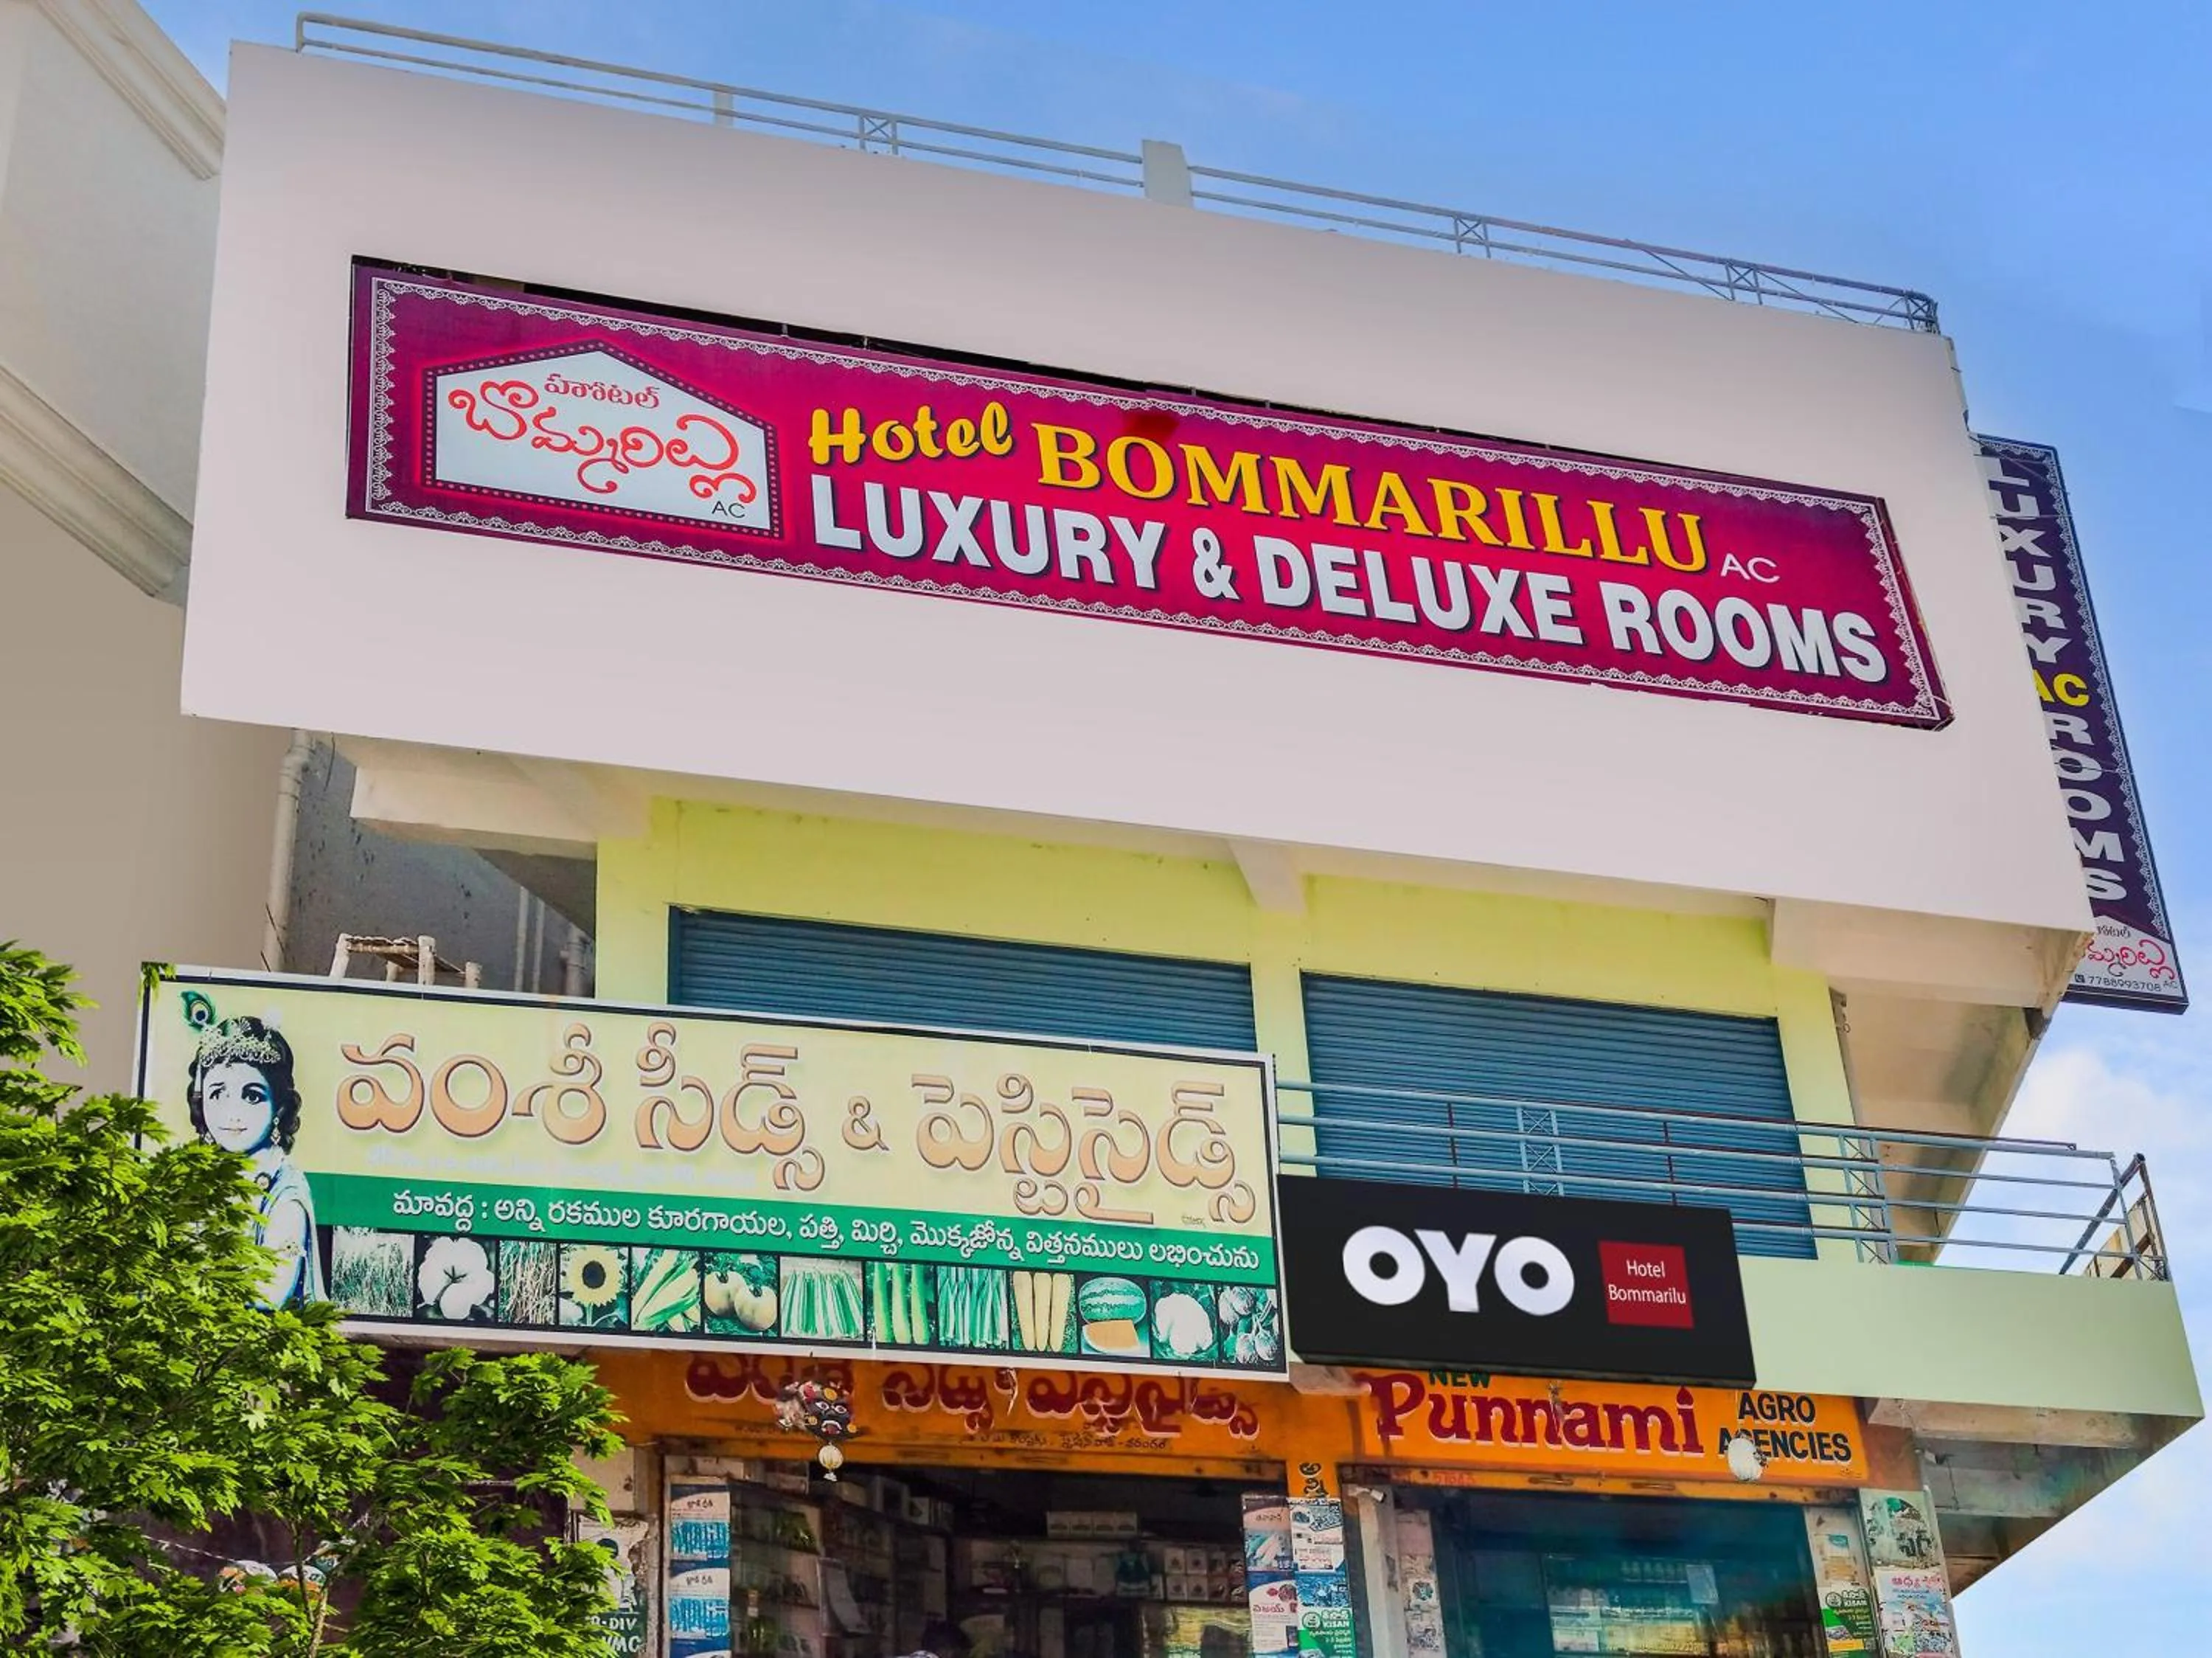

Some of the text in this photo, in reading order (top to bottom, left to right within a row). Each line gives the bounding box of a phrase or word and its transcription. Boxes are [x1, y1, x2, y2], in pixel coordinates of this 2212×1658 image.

[545, 372, 661, 409] హోటల్
[712, 500, 745, 518] AC
[809, 401, 1780, 583] Hotel BOMMARILLU AC
[811, 475, 1888, 684] LUXURY & DELUXE ROOMS
[2045, 712, 2127, 901] ROOMS
[336, 1022, 607, 1145] వంశీ
[634, 1020, 826, 1191] సీడ్స్
[841, 1096, 890, 1151] &
[393, 1190, 474, 1232] మావద్ద
[494, 1198, 546, 1232] అన్ని
[548, 1199, 641, 1228] రకముల
[647, 1204, 793, 1241] కూరగాయల,
[799, 1213, 845, 1249] పత్తి,
[852, 1218, 903, 1255] మిర్చి,
[1026, 1230, 1143, 1264] విత్తనములు
[1149, 1242, 1259, 1269] లభించును
[1343, 1225, 1575, 1317] OYO
[1608, 1283, 1686, 1305] Bommarilu
[1626, 1259, 1665, 1280] Hotel
[1357, 1373, 1705, 1457] Punnami
[1429, 1369, 1491, 1389] NEW
[1738, 1392, 1816, 1424] AGRO
